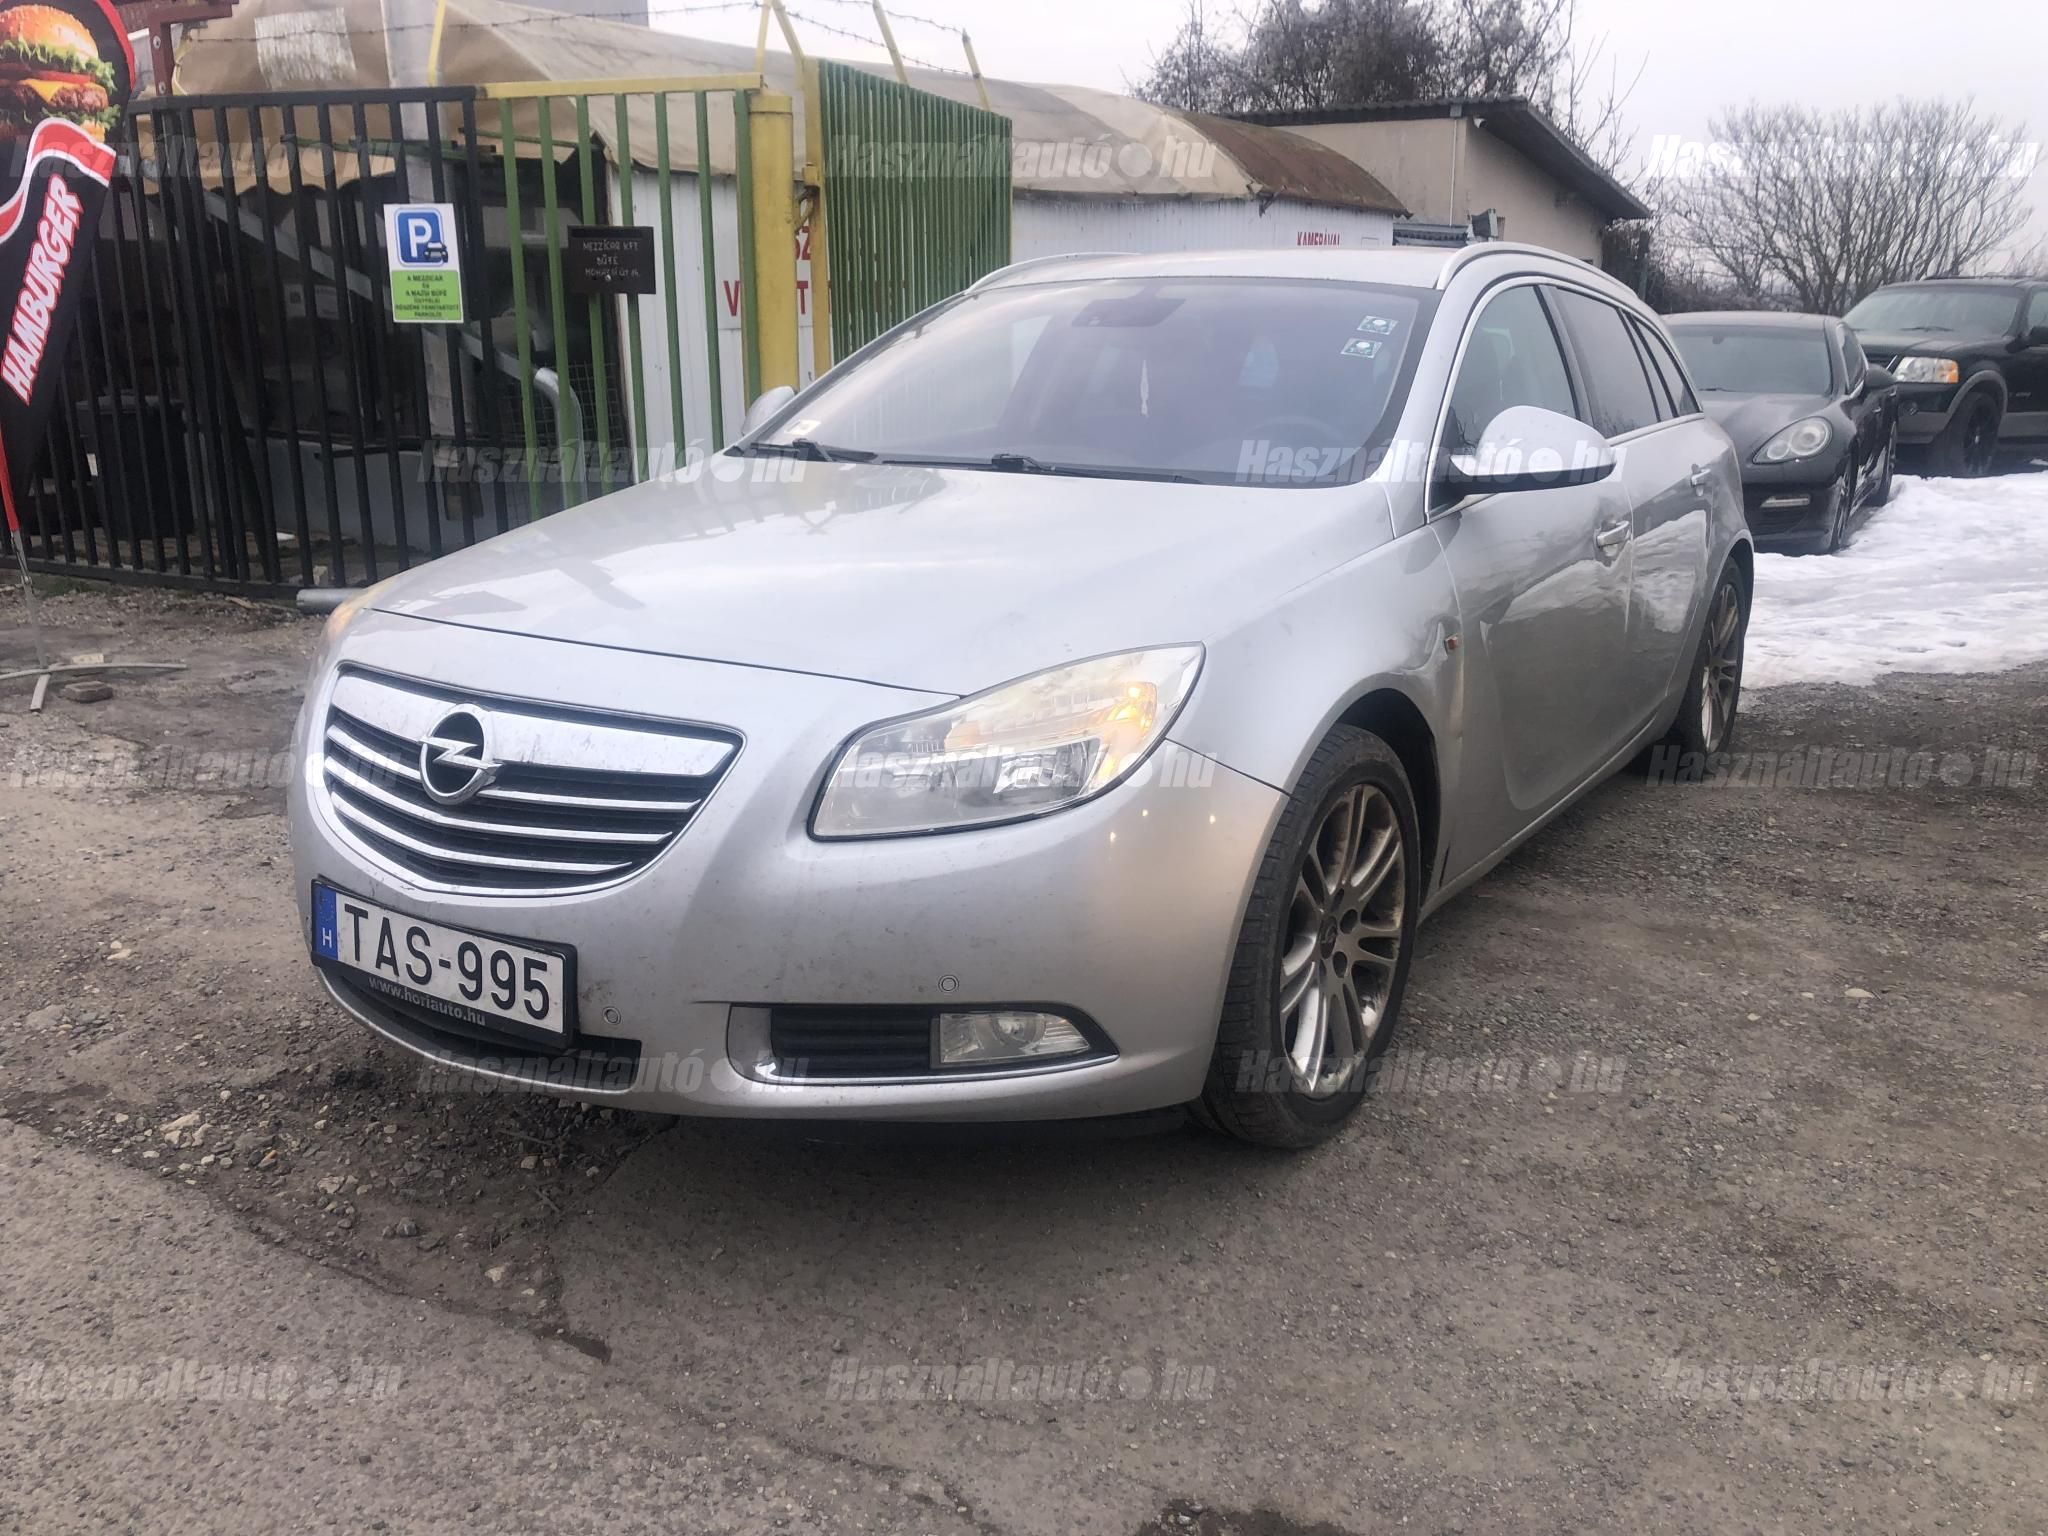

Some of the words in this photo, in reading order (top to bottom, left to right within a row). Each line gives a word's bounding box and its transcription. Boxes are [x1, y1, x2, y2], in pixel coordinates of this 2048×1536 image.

[408, 218, 432, 258] P
[1, 173, 84, 406] HAMBURGER
[322, 927, 332, 949] H
[344, 903, 549, 1020] TAS-995
[368, 976, 486, 1027] www.horiauto.hu
